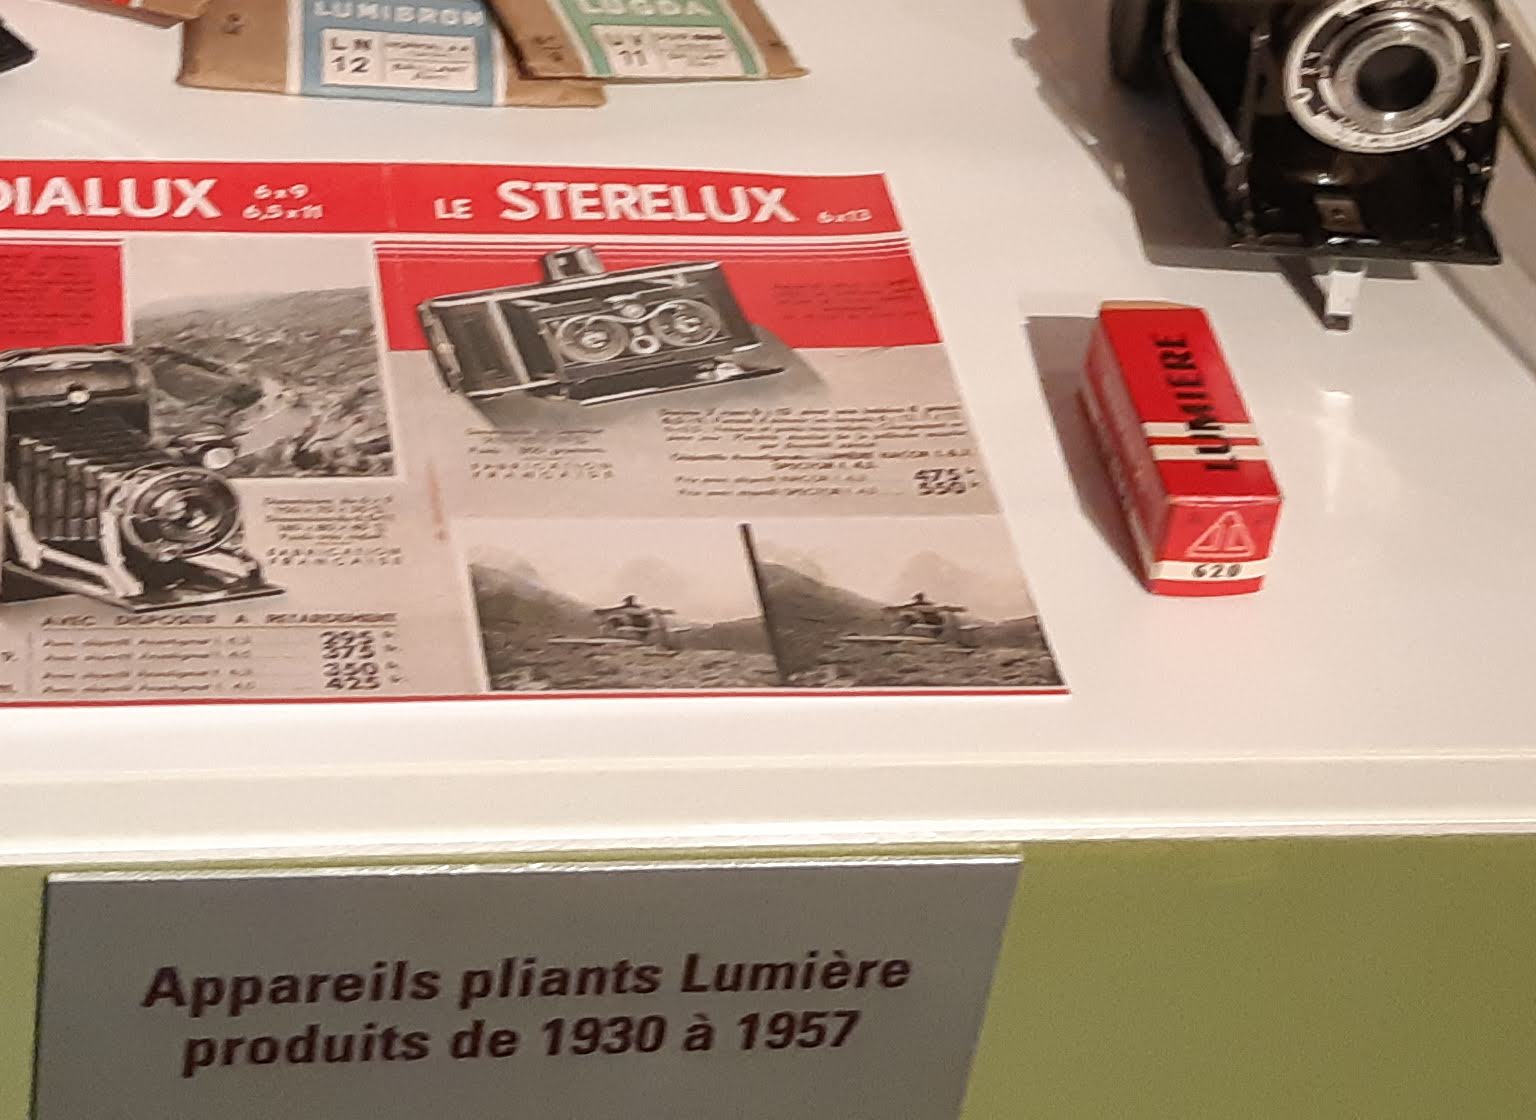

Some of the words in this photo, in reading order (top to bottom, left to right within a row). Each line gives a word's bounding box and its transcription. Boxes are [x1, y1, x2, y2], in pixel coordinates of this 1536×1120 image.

[330, 55, 371, 74] 12
[433, 197, 475, 220] LE
[496, 180, 800, 224] STERELUX
[1192, 563, 1243, 579] 620
[324, 676, 383, 690] 425
[140, 959, 442, 1019] Appareils
[457, 956, 664, 1011] pliants
[679, 949, 913, 995] Lumière
[181, 1021, 432, 1080] produits
[449, 1018, 522, 1060] de
[541, 1013, 668, 1058] 1930
[681, 1011, 716, 1053] à
[737, 1008, 865, 1052] 1957
